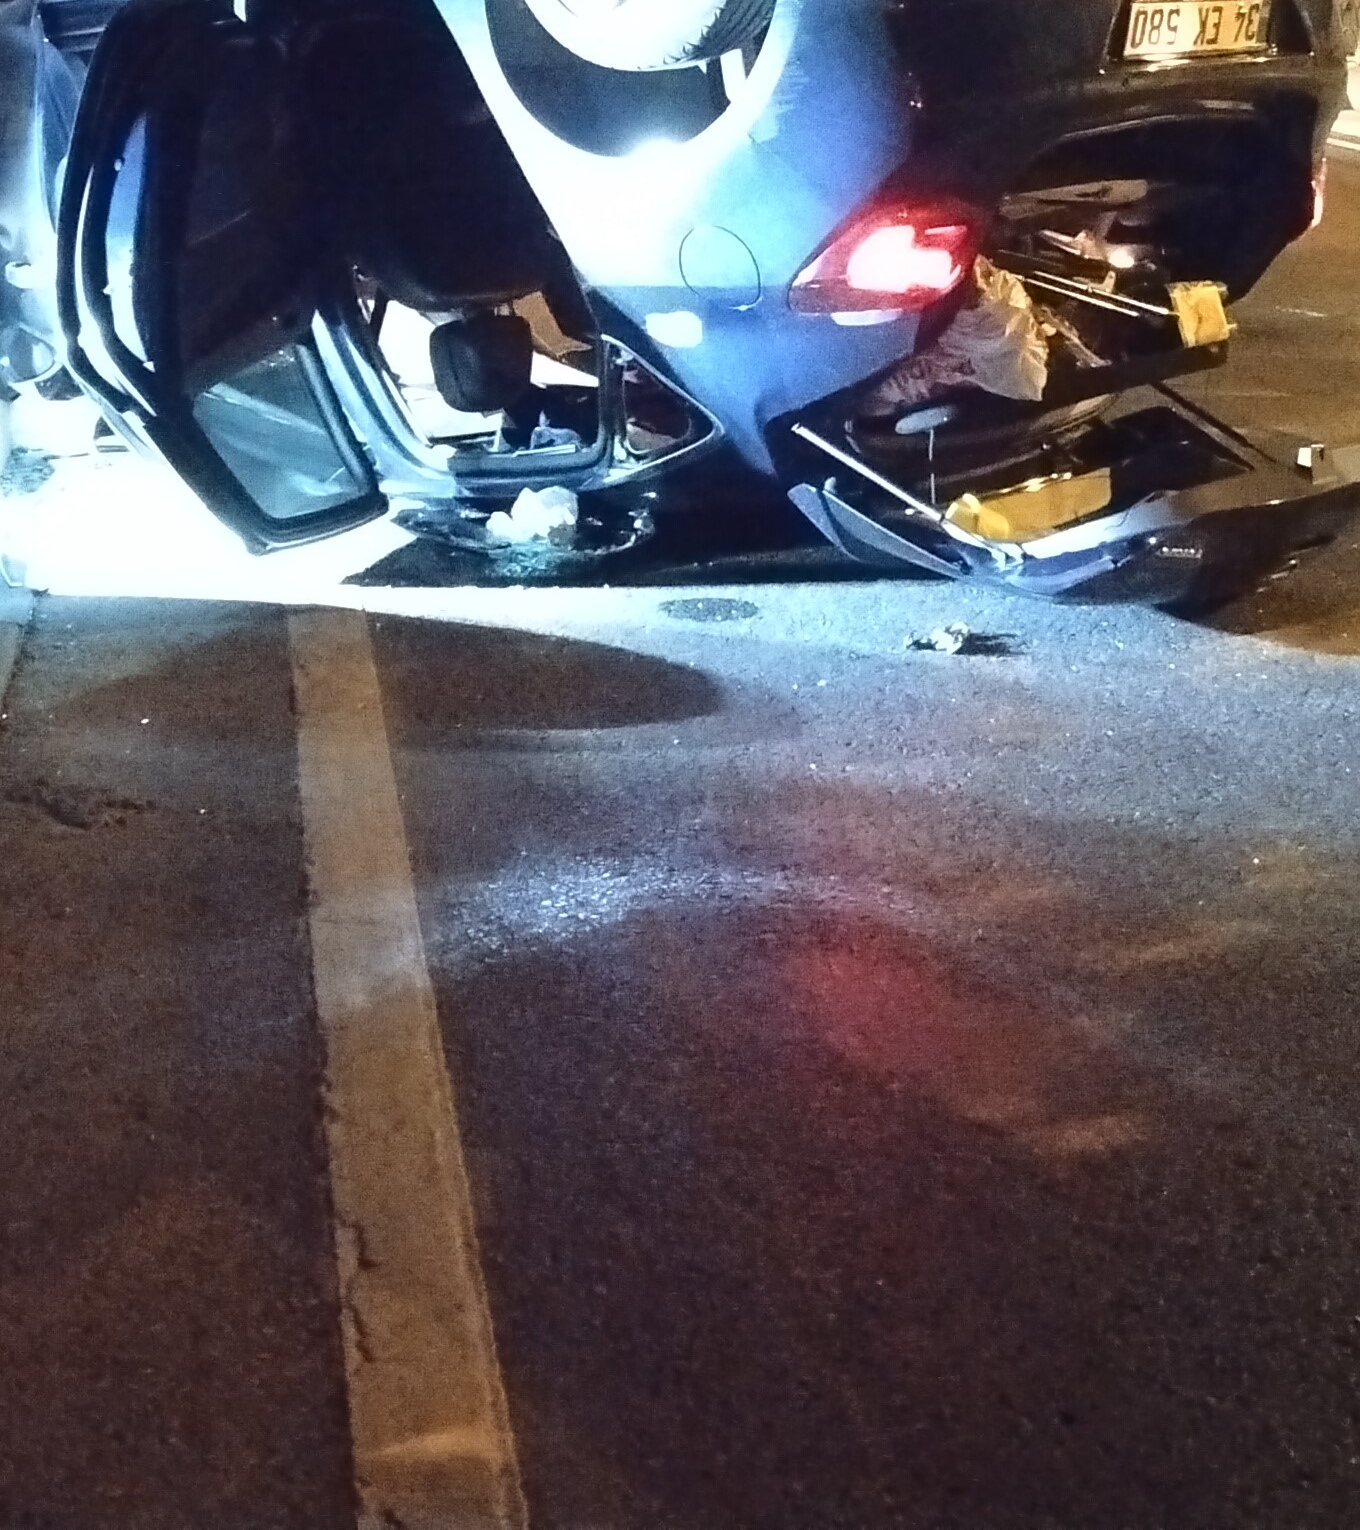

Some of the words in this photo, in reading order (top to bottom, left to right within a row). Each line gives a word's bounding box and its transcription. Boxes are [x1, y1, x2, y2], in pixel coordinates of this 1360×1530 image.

[1130, 7, 1181, 49] 580
[1193, 6, 1223, 46] EK
[1233, 3, 1260, 42] 34
